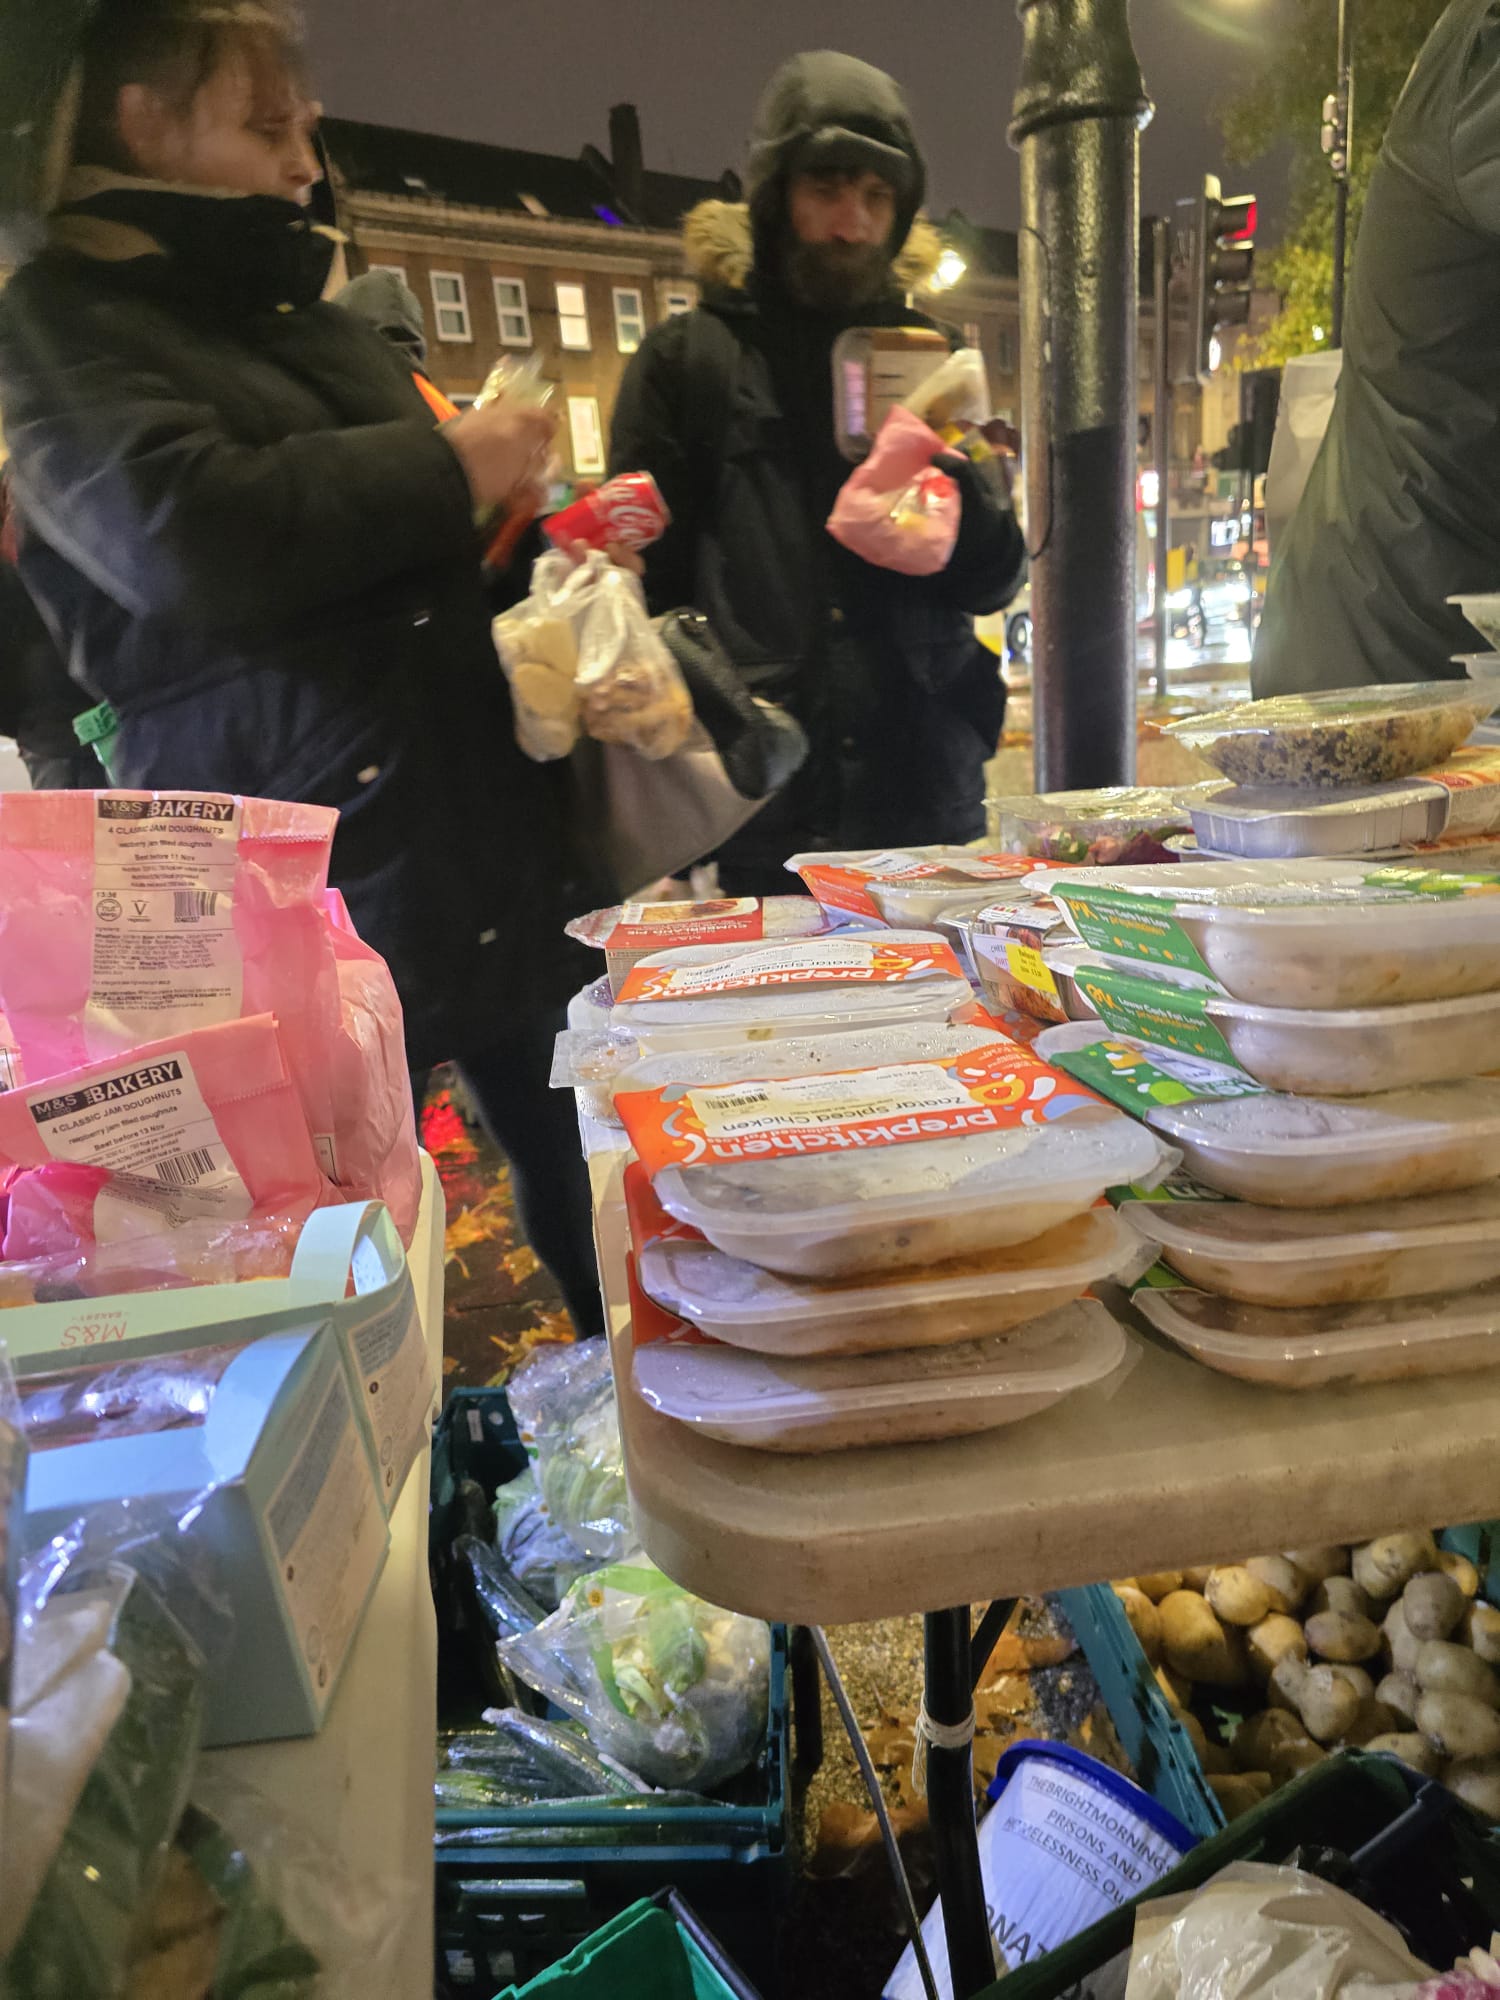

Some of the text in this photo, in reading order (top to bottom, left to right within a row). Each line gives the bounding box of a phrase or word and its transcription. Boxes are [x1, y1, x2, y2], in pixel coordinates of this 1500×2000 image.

[103, 801, 143, 812] M&S
[151, 801, 231, 819] BAKERY
[168, 825, 224, 834] DOUGHNUTS
[662, 968, 874, 996] prepkitchen
[35, 1094, 77, 1115] M&S
[90, 1062, 176, 1102] BAKERY
[59, 1112, 101, 1131] CLASSIC
[104, 1106, 122, 1117] JAM
[123, 1088, 182, 1112] DOUGHNUTS
[816, 1104, 891, 1122] Spiced
[895, 1095, 967, 1111] Zaatar
[69, 1106, 178, 1144] raspberry jam filled doughnuts
[706, 1125, 840, 1144] Balanced Fat Loss
[712, 1107, 998, 1158] prepkitchen
[722, 1113, 811, 1132] Chicken
[94, 1124, 165, 1151] Best before 13 Nov
[60, 1320, 128, 1347] M&S
[1004, 1816, 1099, 1882] HOMELESSNESS
[1048, 1809, 1142, 1884] PRISONS AND
